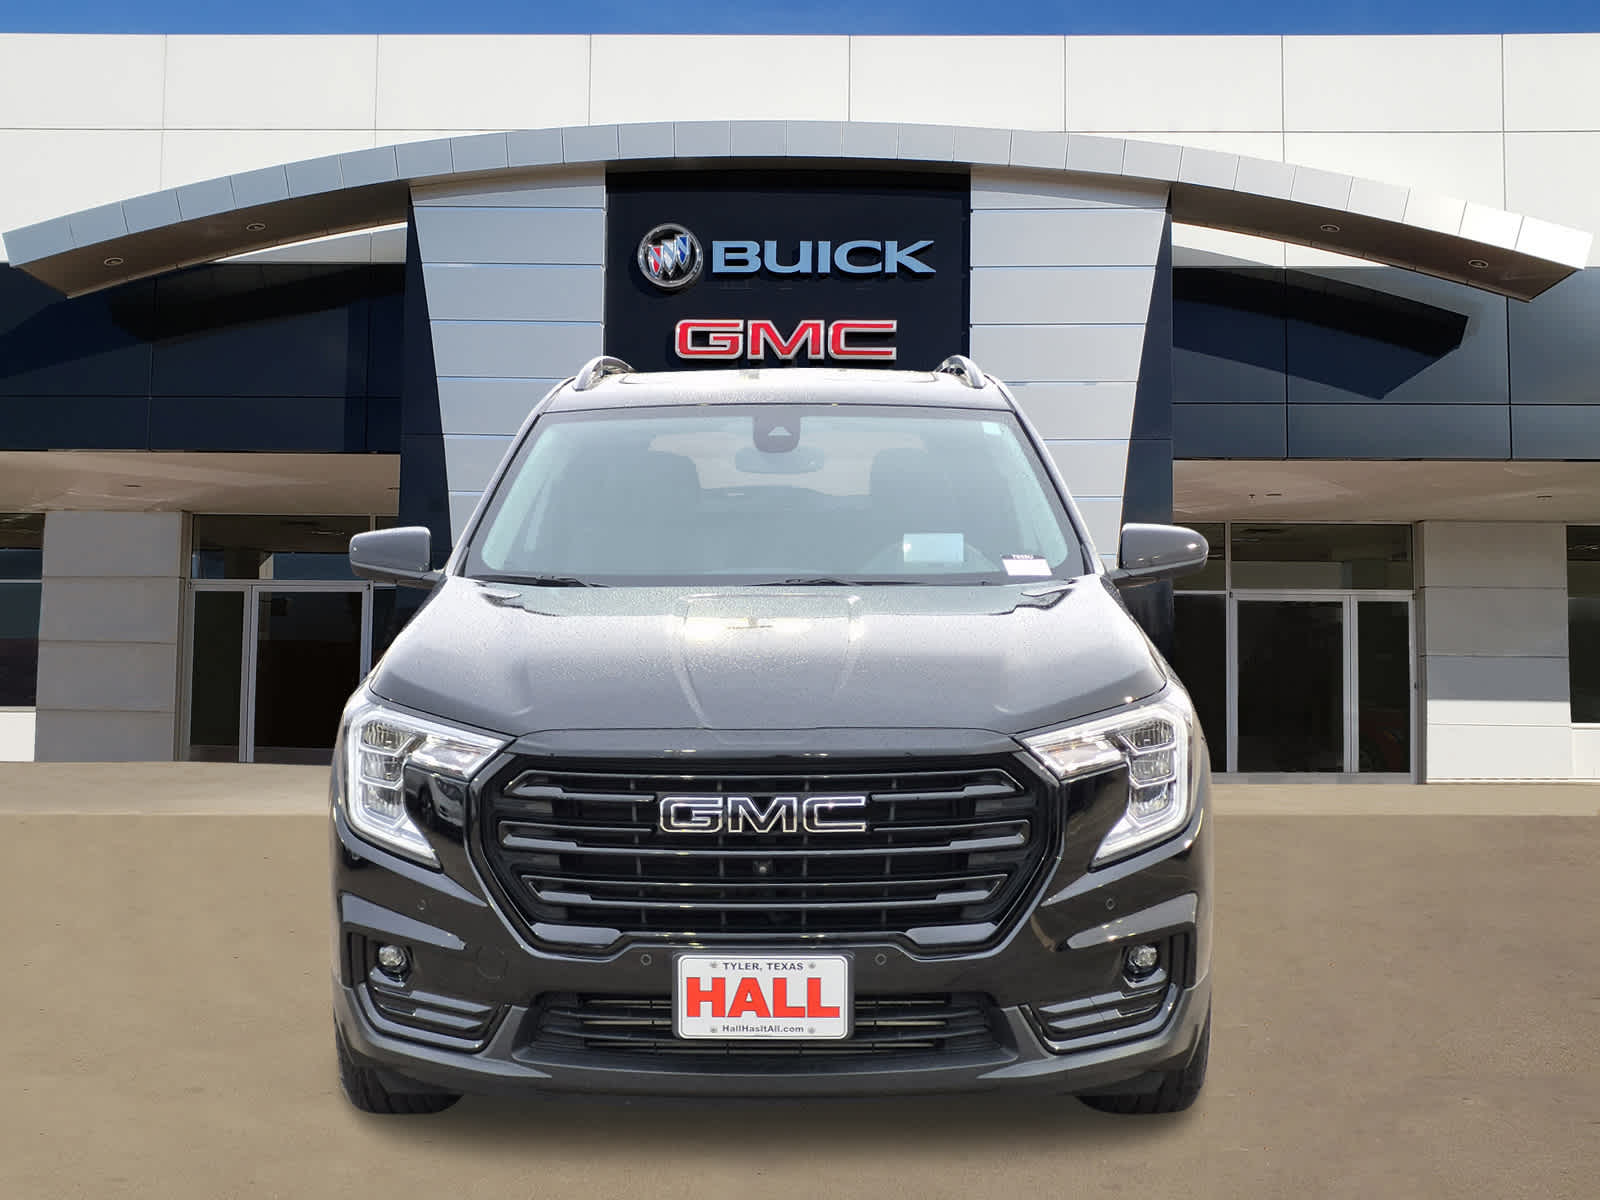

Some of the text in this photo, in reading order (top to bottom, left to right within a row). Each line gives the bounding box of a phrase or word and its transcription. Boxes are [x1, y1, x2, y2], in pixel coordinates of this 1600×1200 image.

[712, 240, 936, 274] BUICK
[675, 319, 897, 361] GMC
[659, 796, 867, 834] GMC
[722, 962, 804, 972] TYLER, TEXAS
[686, 977, 841, 1018] HALL
[722, 1024, 805, 1034] HallHasItAll.com
